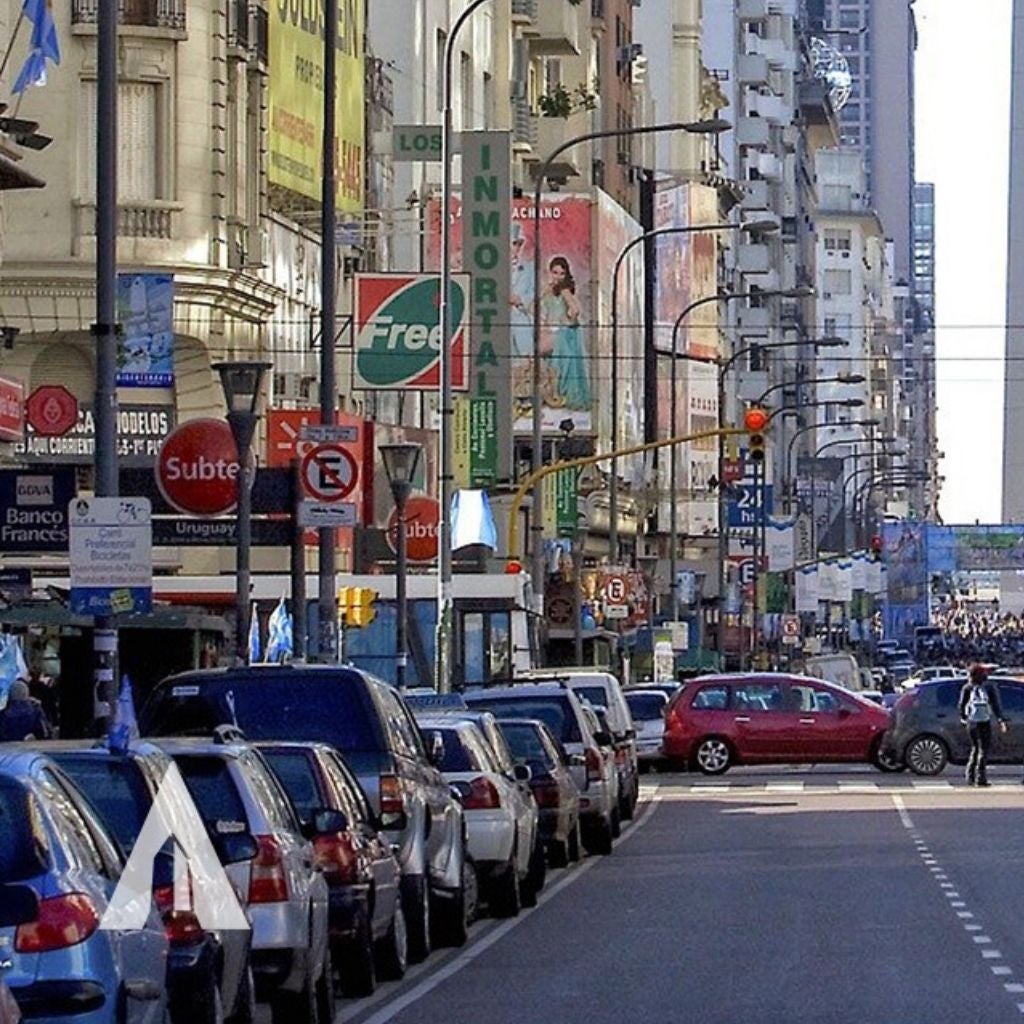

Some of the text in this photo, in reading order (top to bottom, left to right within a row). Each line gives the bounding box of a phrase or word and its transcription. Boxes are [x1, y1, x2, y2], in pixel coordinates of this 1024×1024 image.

[400, 134, 442, 152] LOS
[360, 315, 443, 350] Free
[50, 437, 94, 455] CORRIENT
[147, 440, 163, 455] PIS
[166, 457, 241, 480] Subte
[6, 507, 64, 525] Banco
[1, 524, 69, 542] Francés
[176, 521, 237, 536] Uruguay
